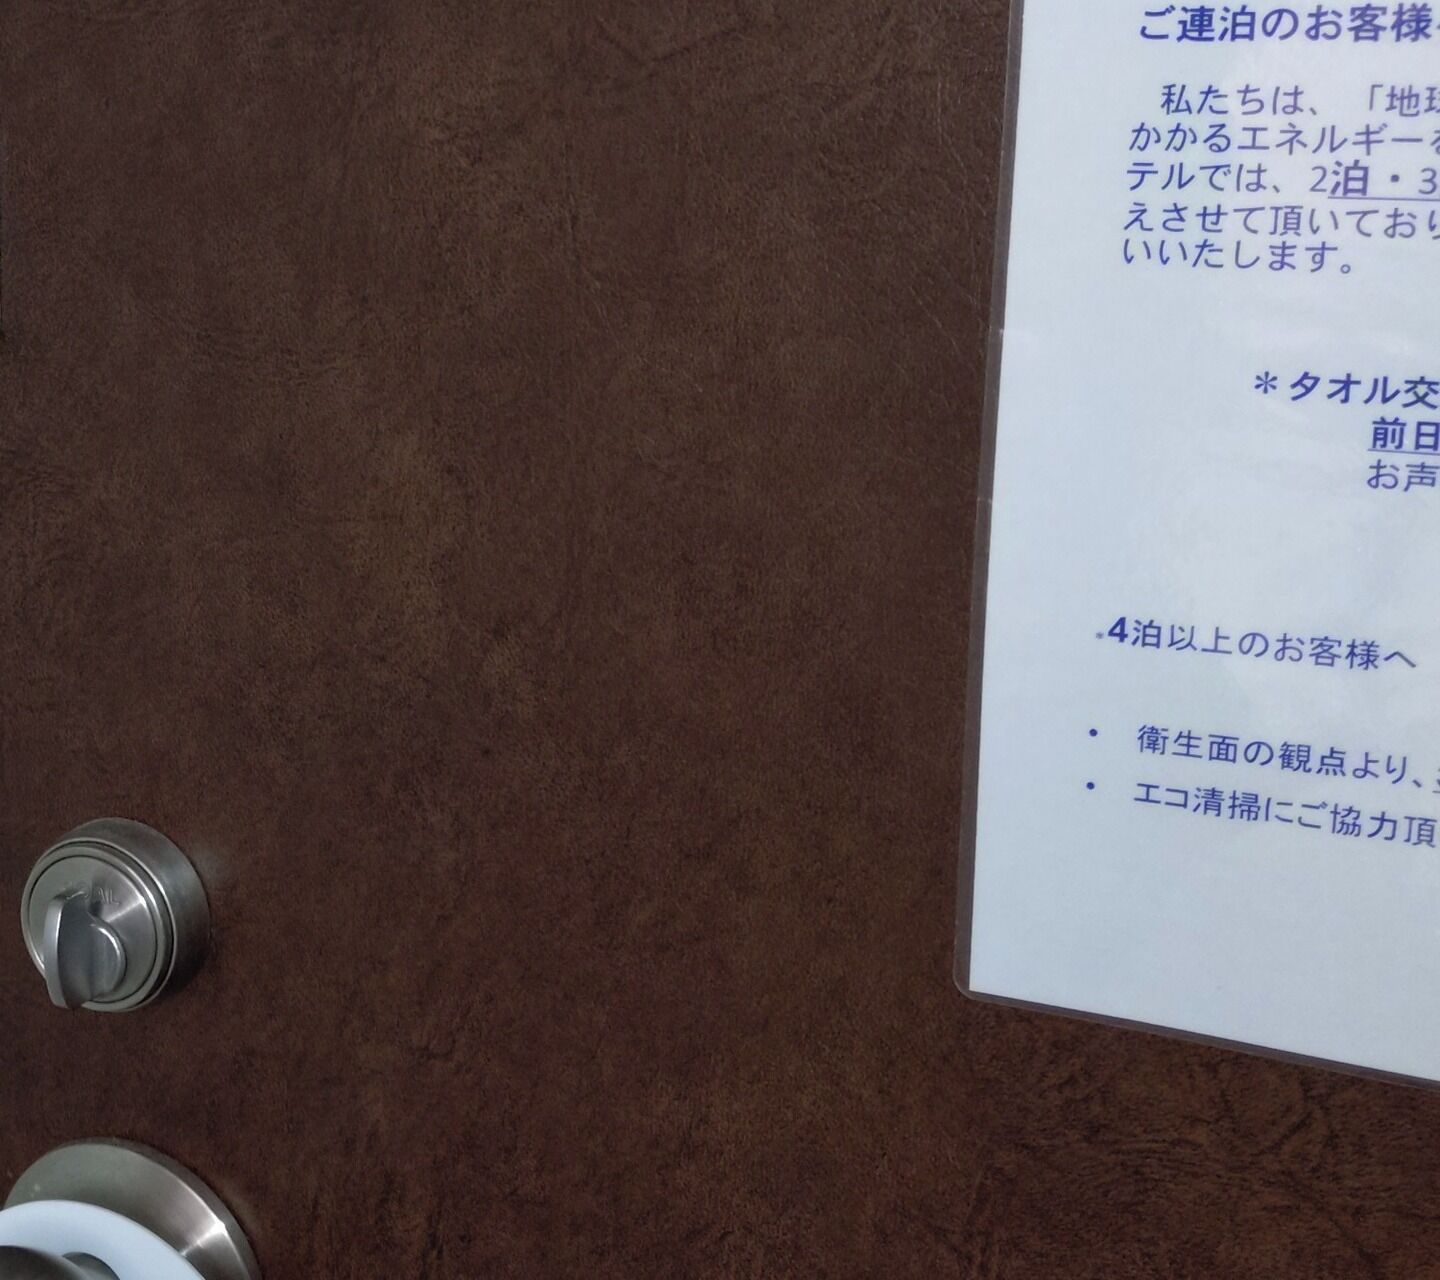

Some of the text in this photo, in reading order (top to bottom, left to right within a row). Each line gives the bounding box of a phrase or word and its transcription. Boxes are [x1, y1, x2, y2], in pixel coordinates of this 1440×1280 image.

[1139, 2, 1440, 43] ご連泊のお客様
[1122, 237, 1353, 275] いいたします。
[1371, 416, 1440, 452] 前日
[1366, 458, 1440, 492] お声
[1136, 723, 1440, 793] 衛生面の観点より、
